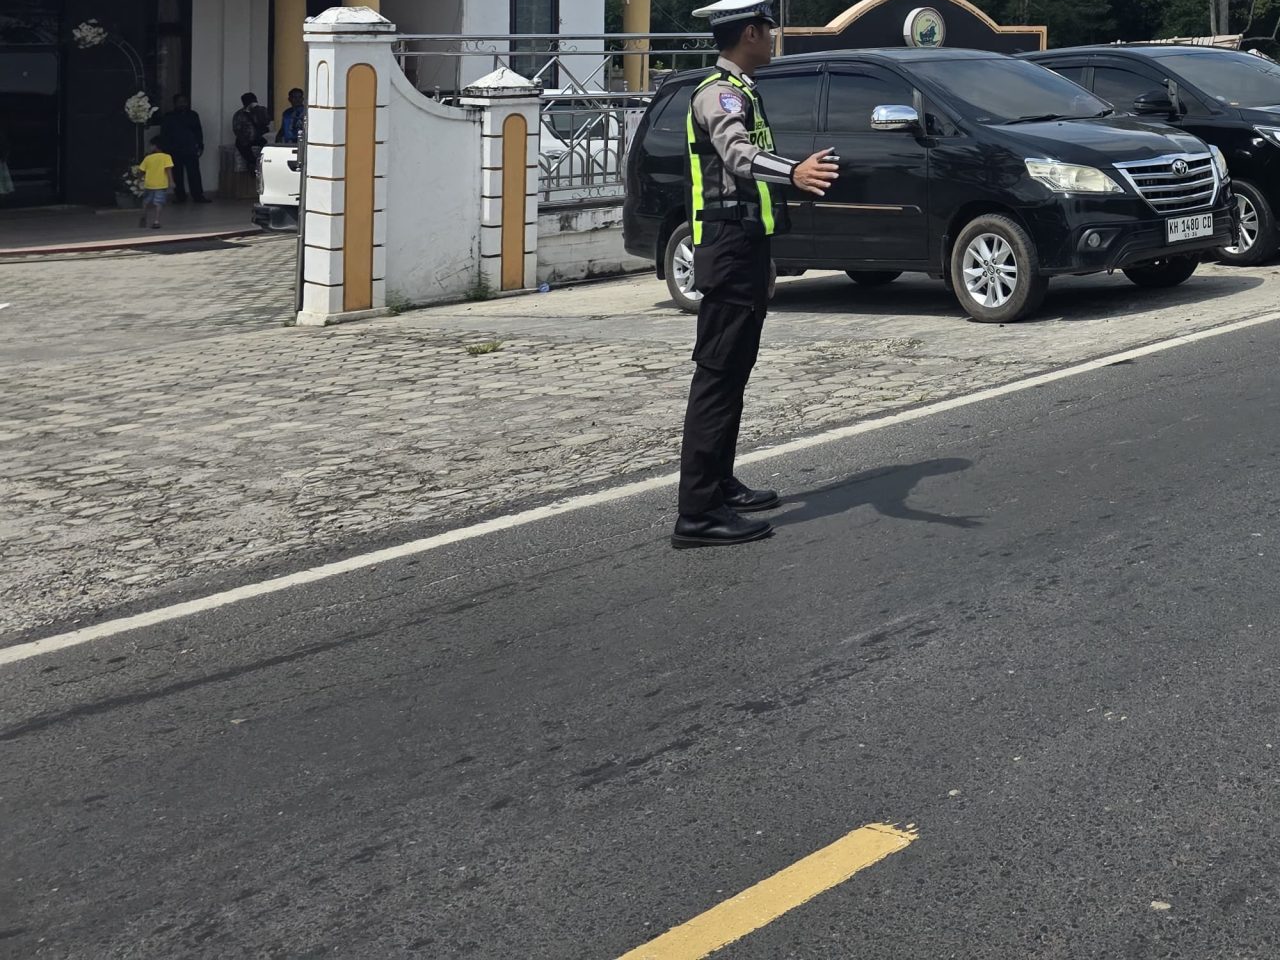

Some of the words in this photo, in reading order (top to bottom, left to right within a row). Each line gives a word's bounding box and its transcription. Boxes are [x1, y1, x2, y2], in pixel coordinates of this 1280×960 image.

[1169, 221, 1179, 234] KH
[1181, 218, 1200, 232] 1480
[1203, 216, 1211, 229] CD
